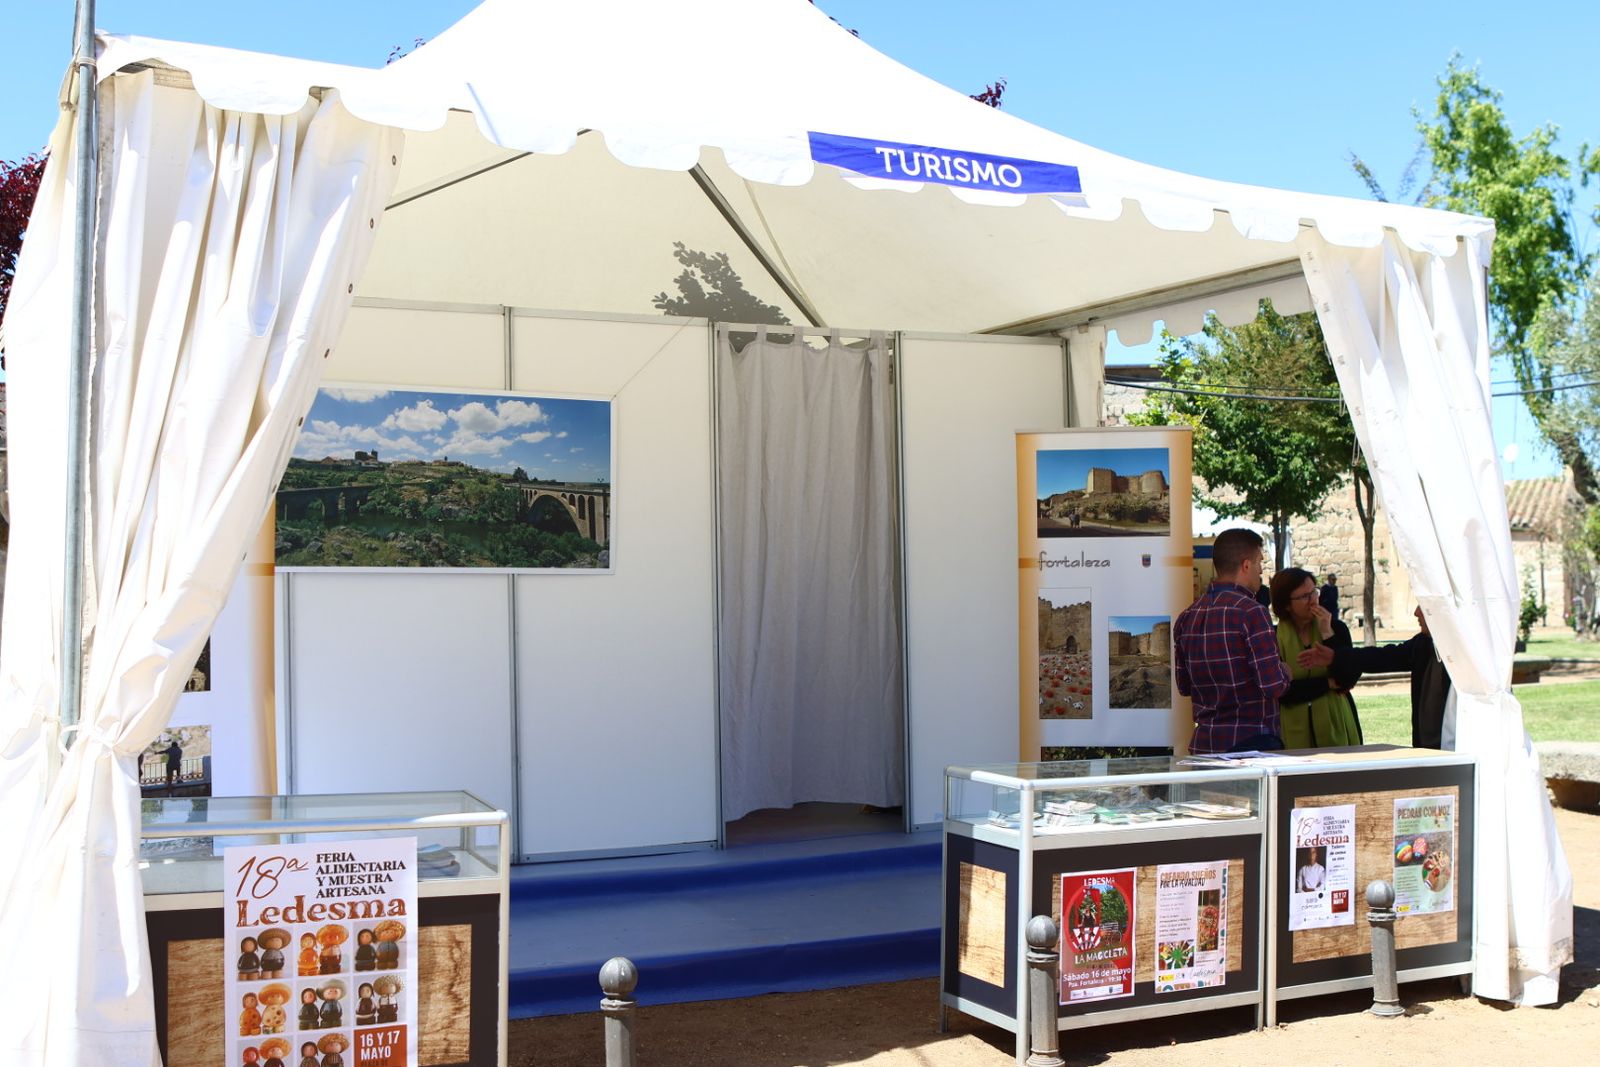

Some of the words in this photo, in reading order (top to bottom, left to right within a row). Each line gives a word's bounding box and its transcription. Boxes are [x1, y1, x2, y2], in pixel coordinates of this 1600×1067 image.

[874, 146, 1022, 188] TURISMO
[1038, 551, 1111, 571] fortaleza
[1296, 834, 1349, 846] Ledesma
[316, 852, 355, 863] FERIA
[316, 860, 406, 875] ALIMENTARIA
[316, 877, 326, 887] Y
[329, 873, 393, 886] MUESTRA
[316, 885, 386, 899] ARTESANA
[236, 895, 407, 927] Ledesma
[1075, 955, 1085, 964] LA
[1063, 972, 1089, 981] Sábado
[1112, 968, 1131, 976] mayo
[360, 1033, 373, 1047] 16
[377, 1032, 384, 1046] Y
[387, 1030, 400, 1044] 17
[361, 1045, 391, 1060] MAYO
